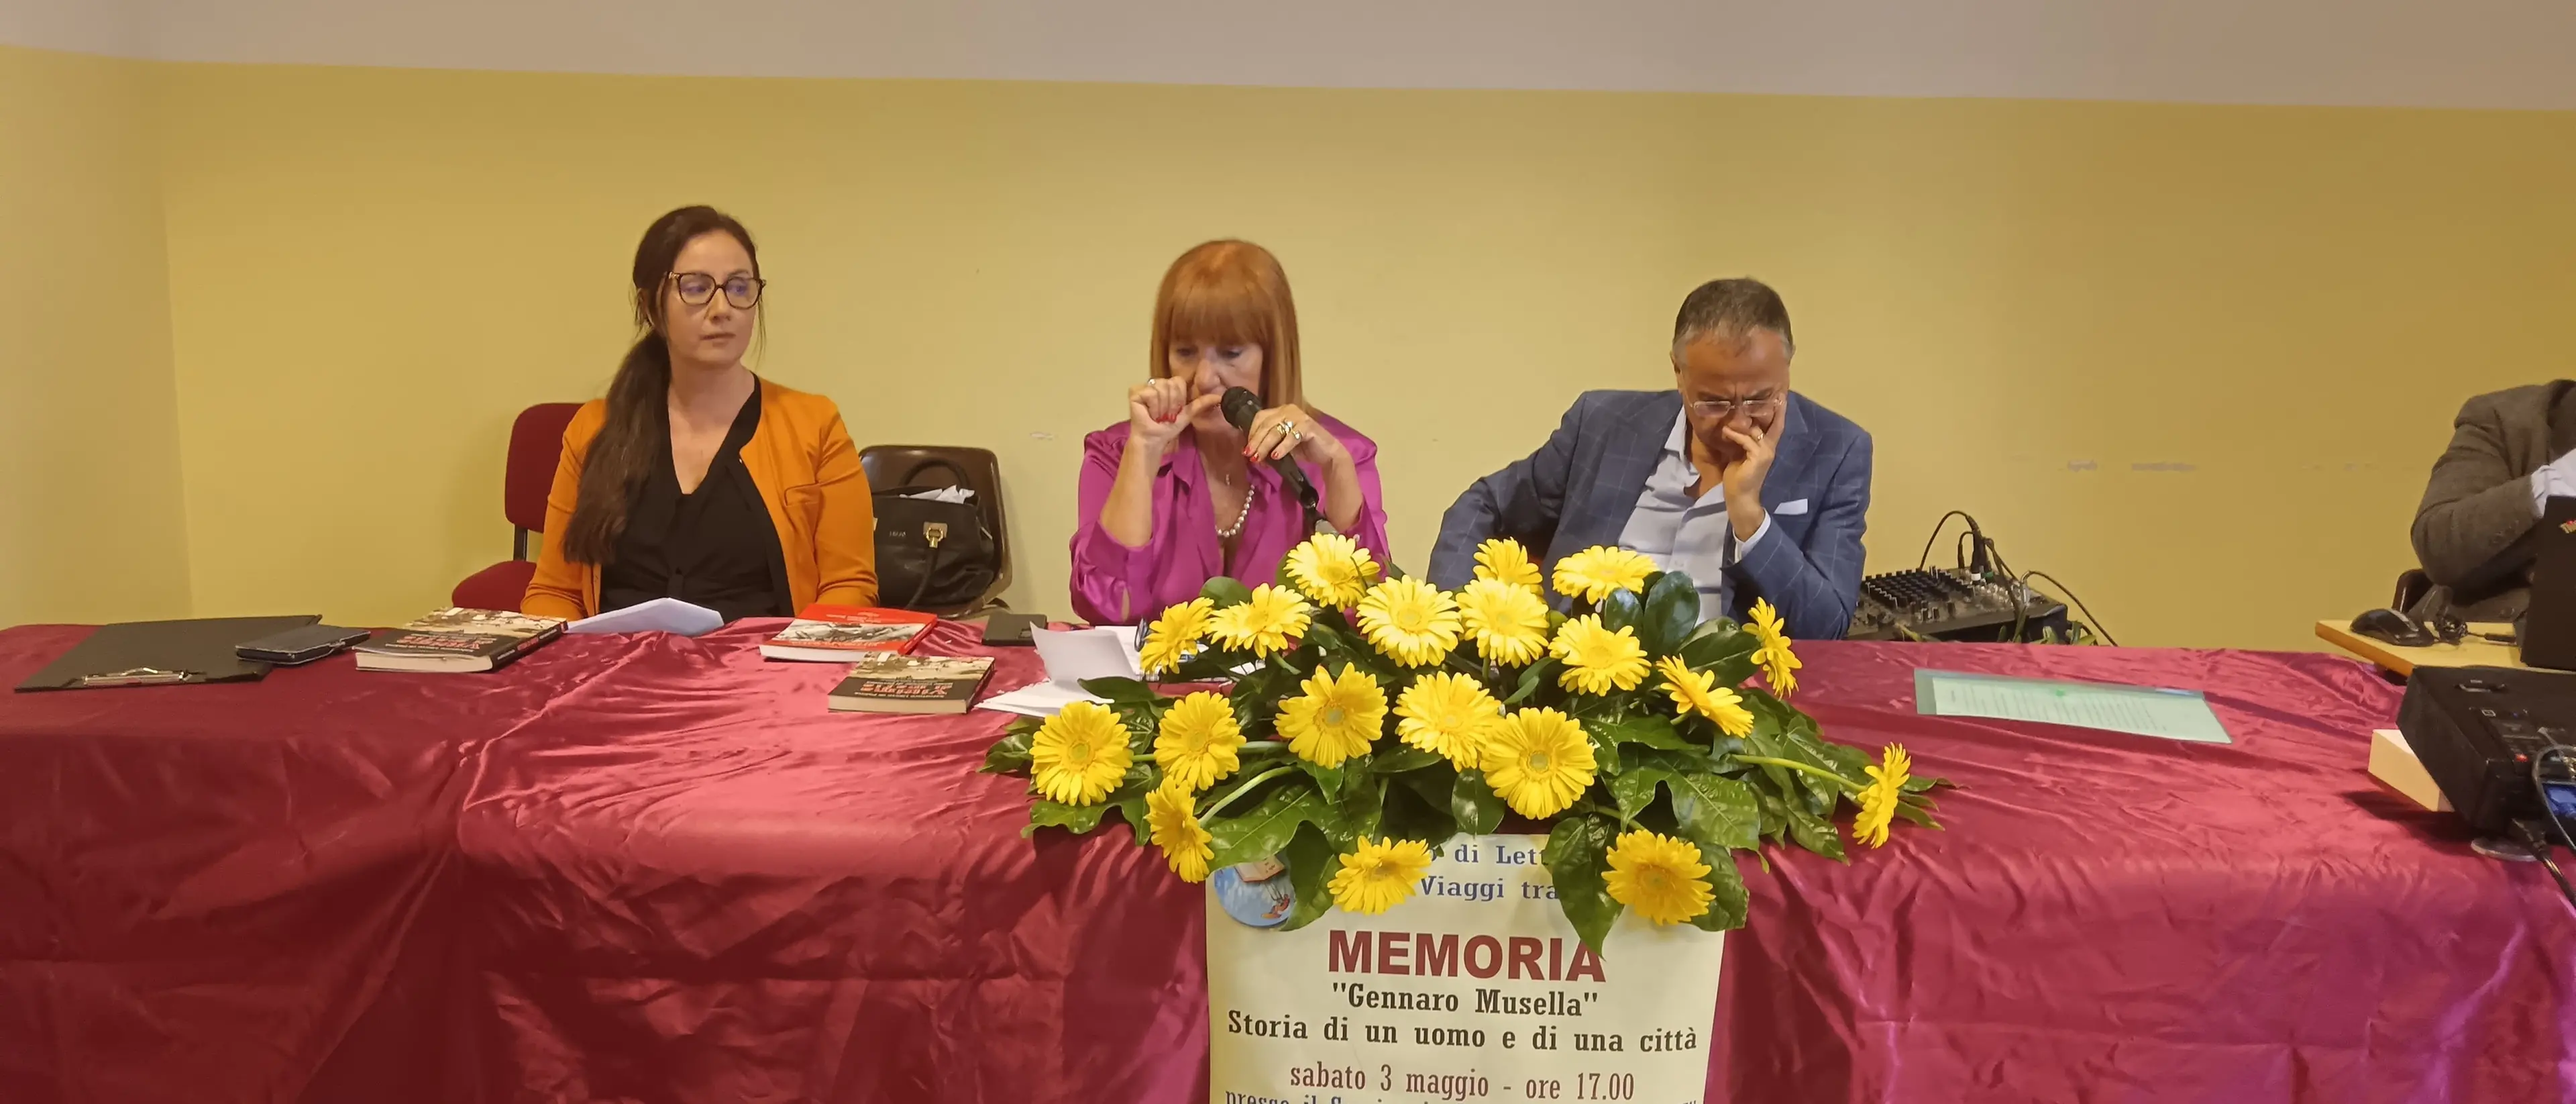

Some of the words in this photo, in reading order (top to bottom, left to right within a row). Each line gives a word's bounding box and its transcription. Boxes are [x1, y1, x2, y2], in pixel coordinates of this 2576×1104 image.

[1455, 844, 1478, 862] di
[1421, 876, 1503, 901] Viaggi
[1329, 930, 1606, 982] MEMORIA
[1334, 983, 1458, 1011] "Gennaro
[1475, 989, 1597, 1016] Musella"
[1229, 1010, 1307, 1039] Storia
[1324, 1017, 1348, 1041] di
[1365, 1025, 1397, 1043] un
[1415, 1027, 1485, 1047] uomo
[1503, 1032, 1515, 1048] e
[1533, 1025, 1556, 1050] di
[1574, 1034, 1623, 1051] una
[1640, 1027, 1696, 1052] città
[1291, 1061, 1365, 1089] sabato
[1381, 1064, 1391, 1091] 3
[1406, 1069, 1488, 1101] maggio
[1527, 1080, 1560, 1099] ore
[1578, 1073, 1633, 1100] 17.00
